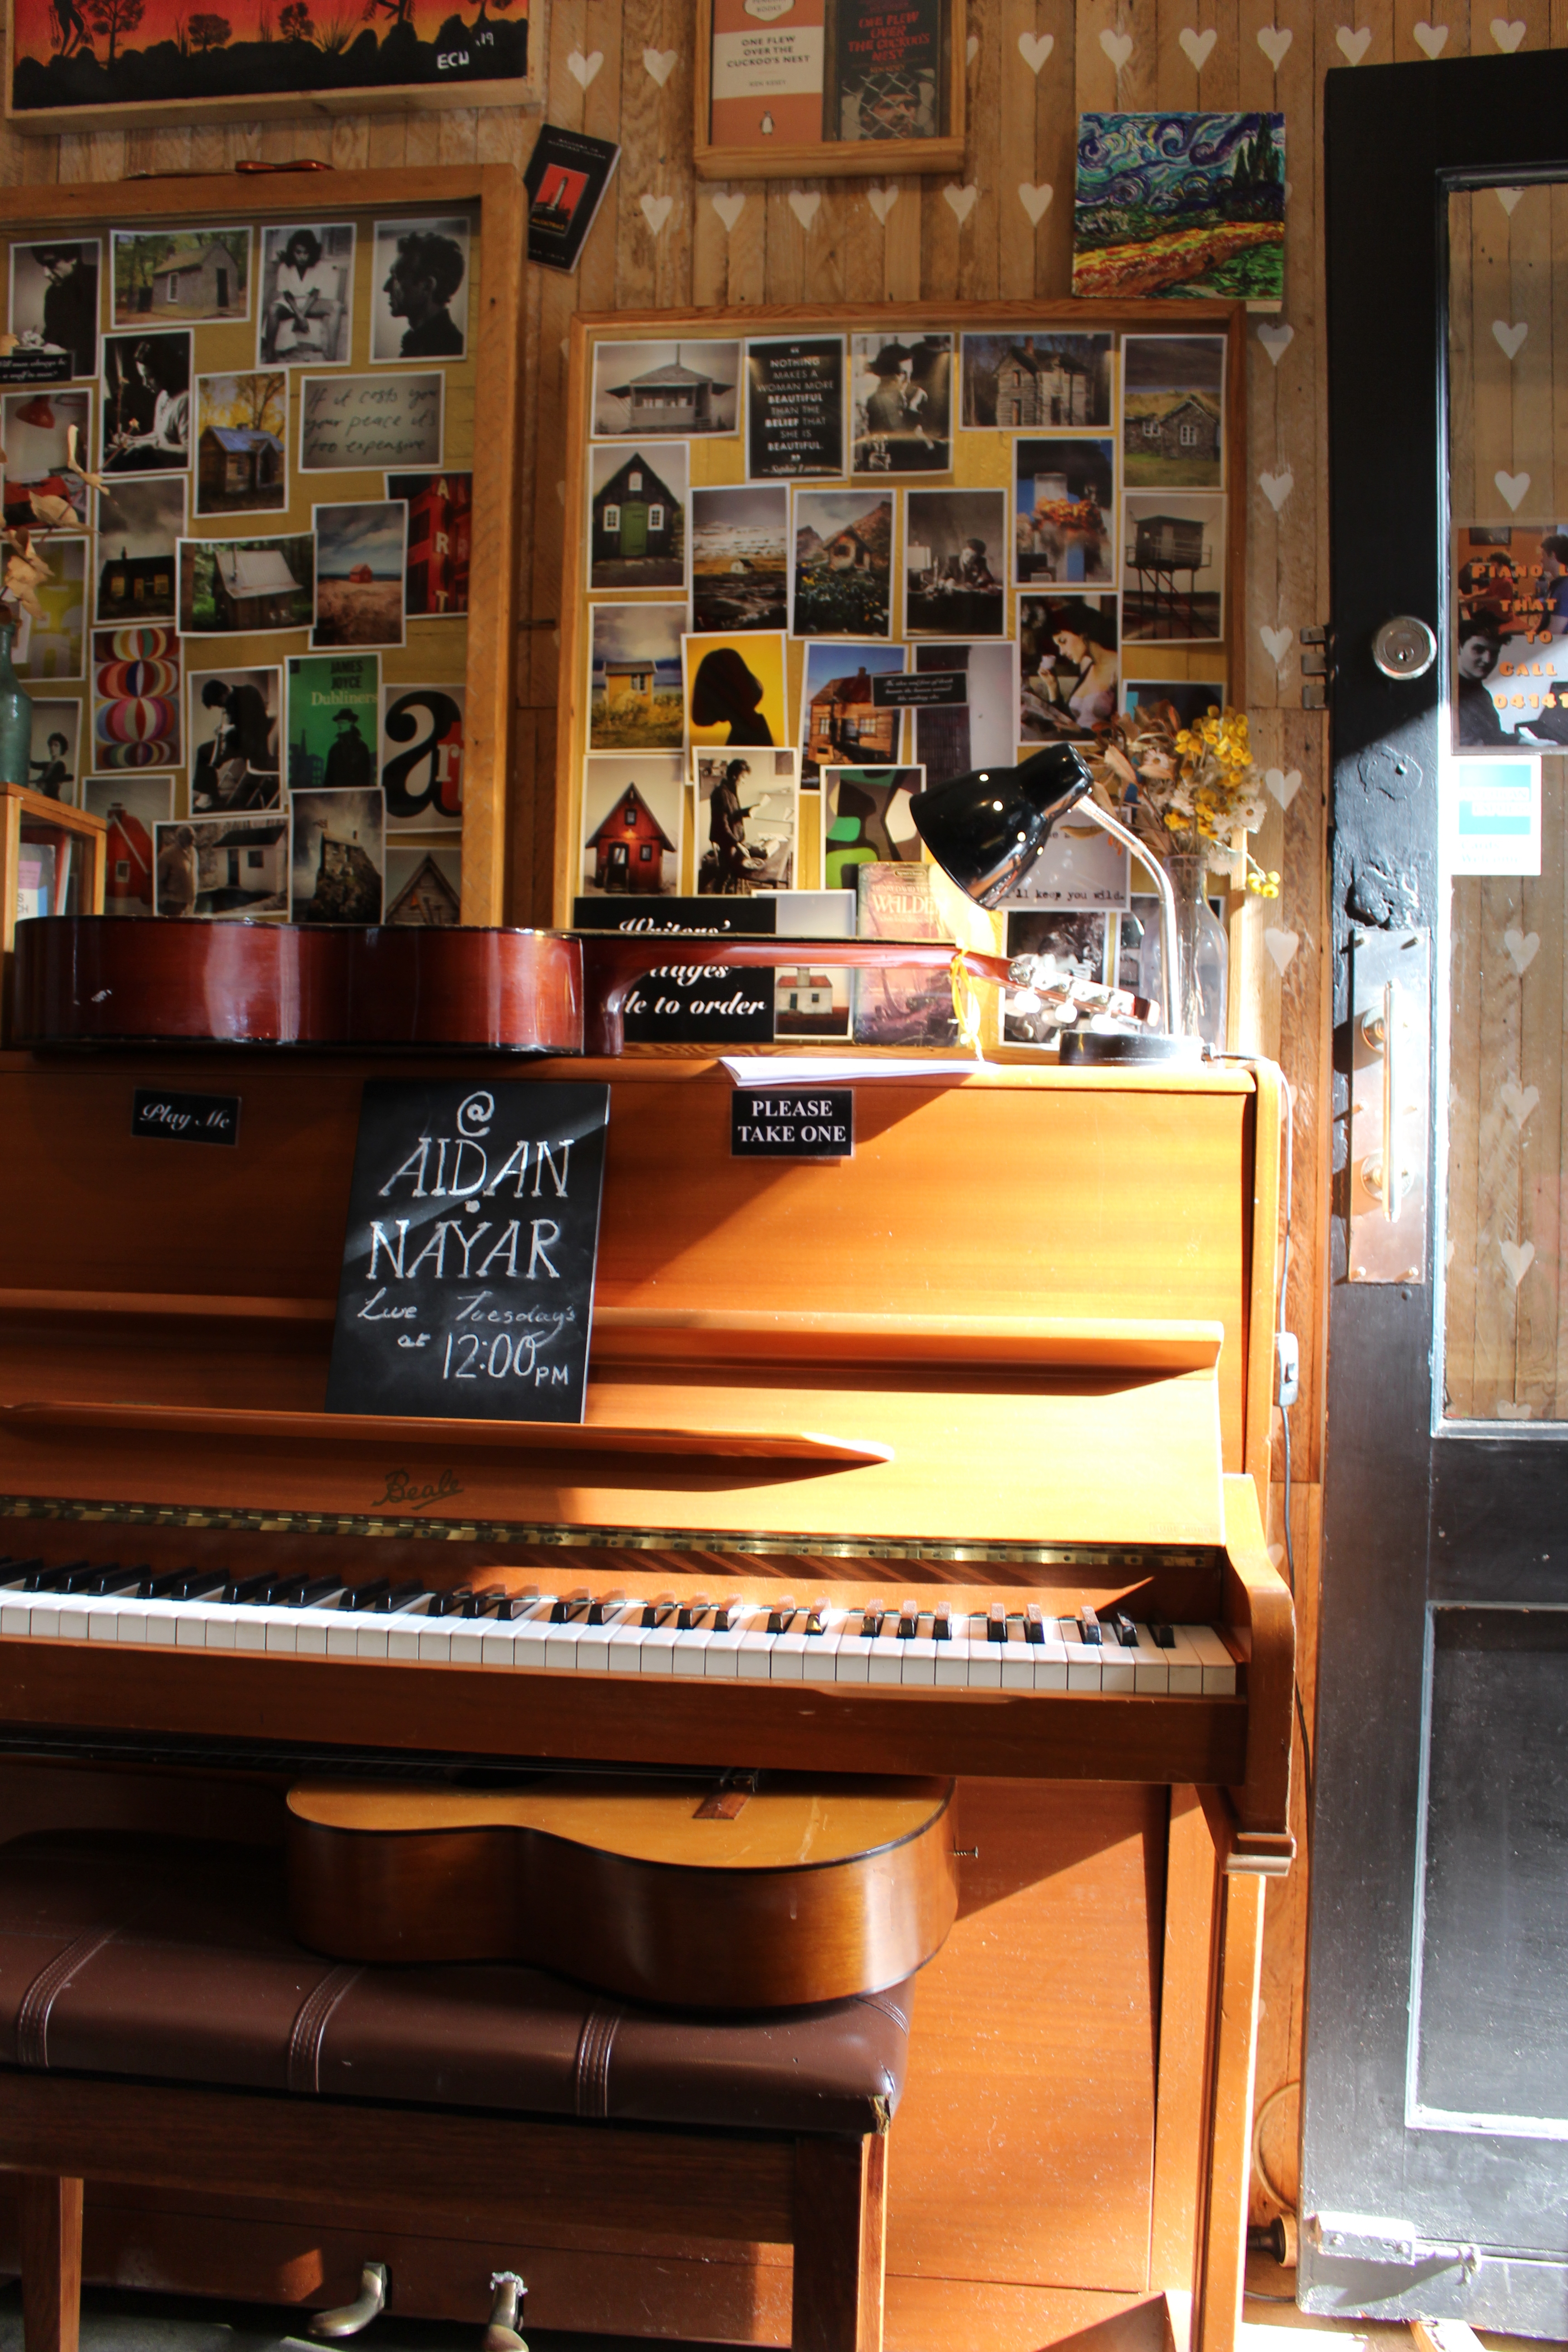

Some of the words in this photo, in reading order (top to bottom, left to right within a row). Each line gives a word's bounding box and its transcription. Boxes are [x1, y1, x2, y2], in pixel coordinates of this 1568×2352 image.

[741, 38, 763, 46] ONE
[767, 35, 795, 44] FLEW
[848, 39, 873, 52] THE
[744, 47, 770, 56] OVER
[727, 56, 779, 68] CUCKOO'S
[770, 357, 820, 368] NOTHING
[773, 370, 808, 379] MAKES
[811, 369, 818, 377] A
[756, 383, 801, 392] WOMAN
[804, 381, 834, 390] MORE
[768, 393, 823, 404] BEAUTIFUL
[771, 406, 799, 415] THAN
[802, 405, 820, 414] THE
[345, 415, 402, 436] peace
[764, 417, 799, 428] BELIEF
[802, 416, 826, 425] THAT
[780, 430, 799, 439] SHE
[802, 429, 812, 438] IS
[1471, 565, 1543, 578] PIANO
[1500, 599, 1557, 612] THAT
[1525, 631, 1553, 644] TO
[1499, 662, 1557, 676] CALL
[1493, 693, 1568, 709] 04141
[1067, 891, 1088, 901] you
[654, 997, 681, 1014] to
[690, 991, 767, 1014] order
[456, 1090, 495, 1137] @
[751, 1100, 833, 1117] PLEASE
[139, 1103, 191, 1131] Play
[737, 1125, 795, 1142] TAKE
[801, 1125, 846, 1142] ONE
[378, 1137, 575, 1199] AIDAN
[366, 1219, 561, 1279] NAYAR
[357, 1287, 418, 1320] Live
[371, 1468, 464, 1510] Beale
